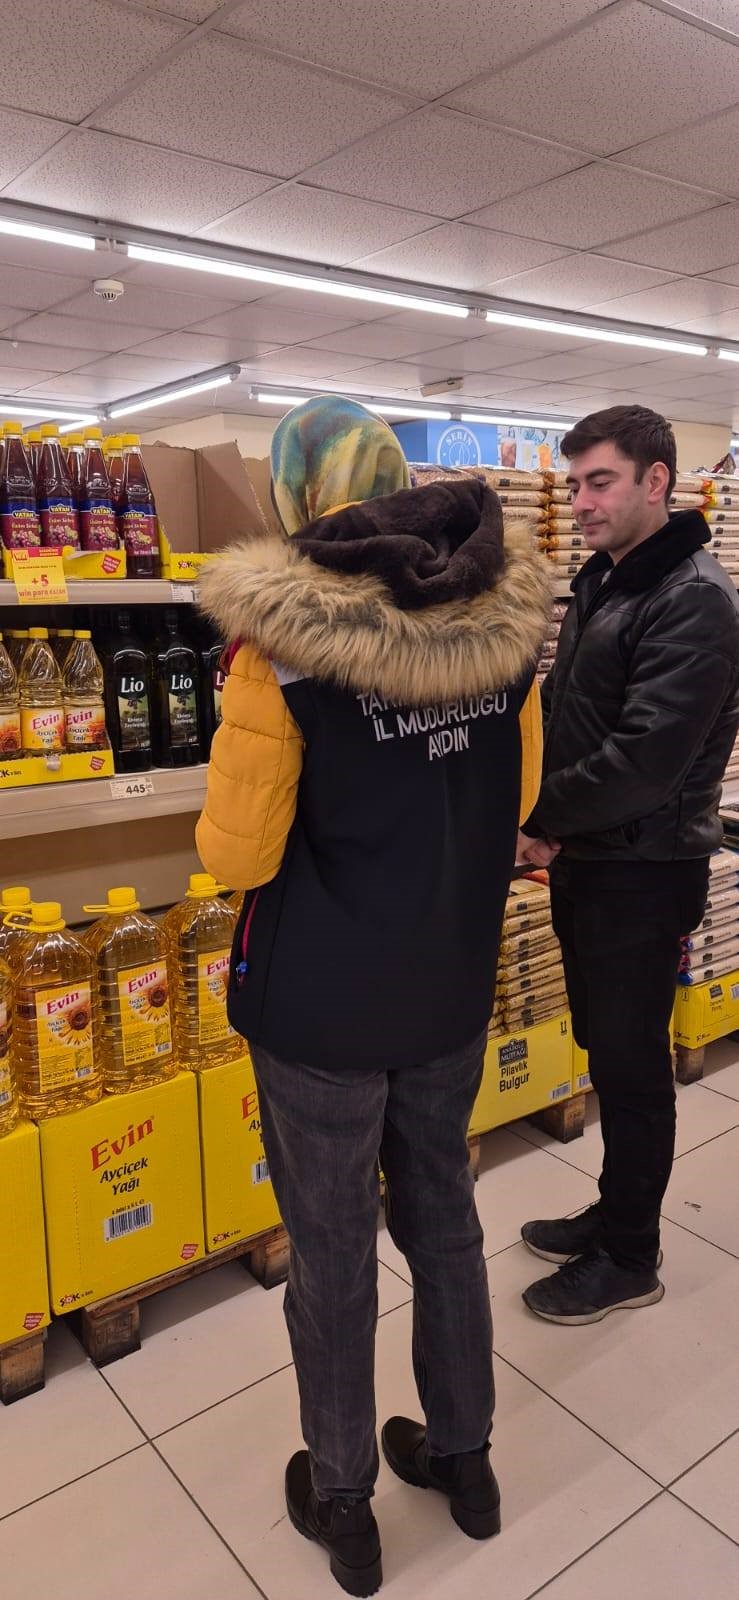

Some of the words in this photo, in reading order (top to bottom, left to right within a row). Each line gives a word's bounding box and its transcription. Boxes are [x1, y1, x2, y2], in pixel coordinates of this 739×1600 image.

[121, 677, 144, 693] Lio
[171, 674, 193, 690] Lio
[32, 712, 60, 730] Evin
[66, 710, 93, 726] Evin
[372, 714, 394, 742] İL
[428, 725, 470, 761] AYDIN
[126, 784, 145, 794] 445
[127, 969, 158, 993] Evin
[46, 991, 80, 1015] Evin
[499, 1072, 530, 1093] Bulgur
[90, 1118, 154, 1171] Evin
[100, 1157, 149, 1183] Ayçiçek
[112, 1178, 140, 1195] Yağı
